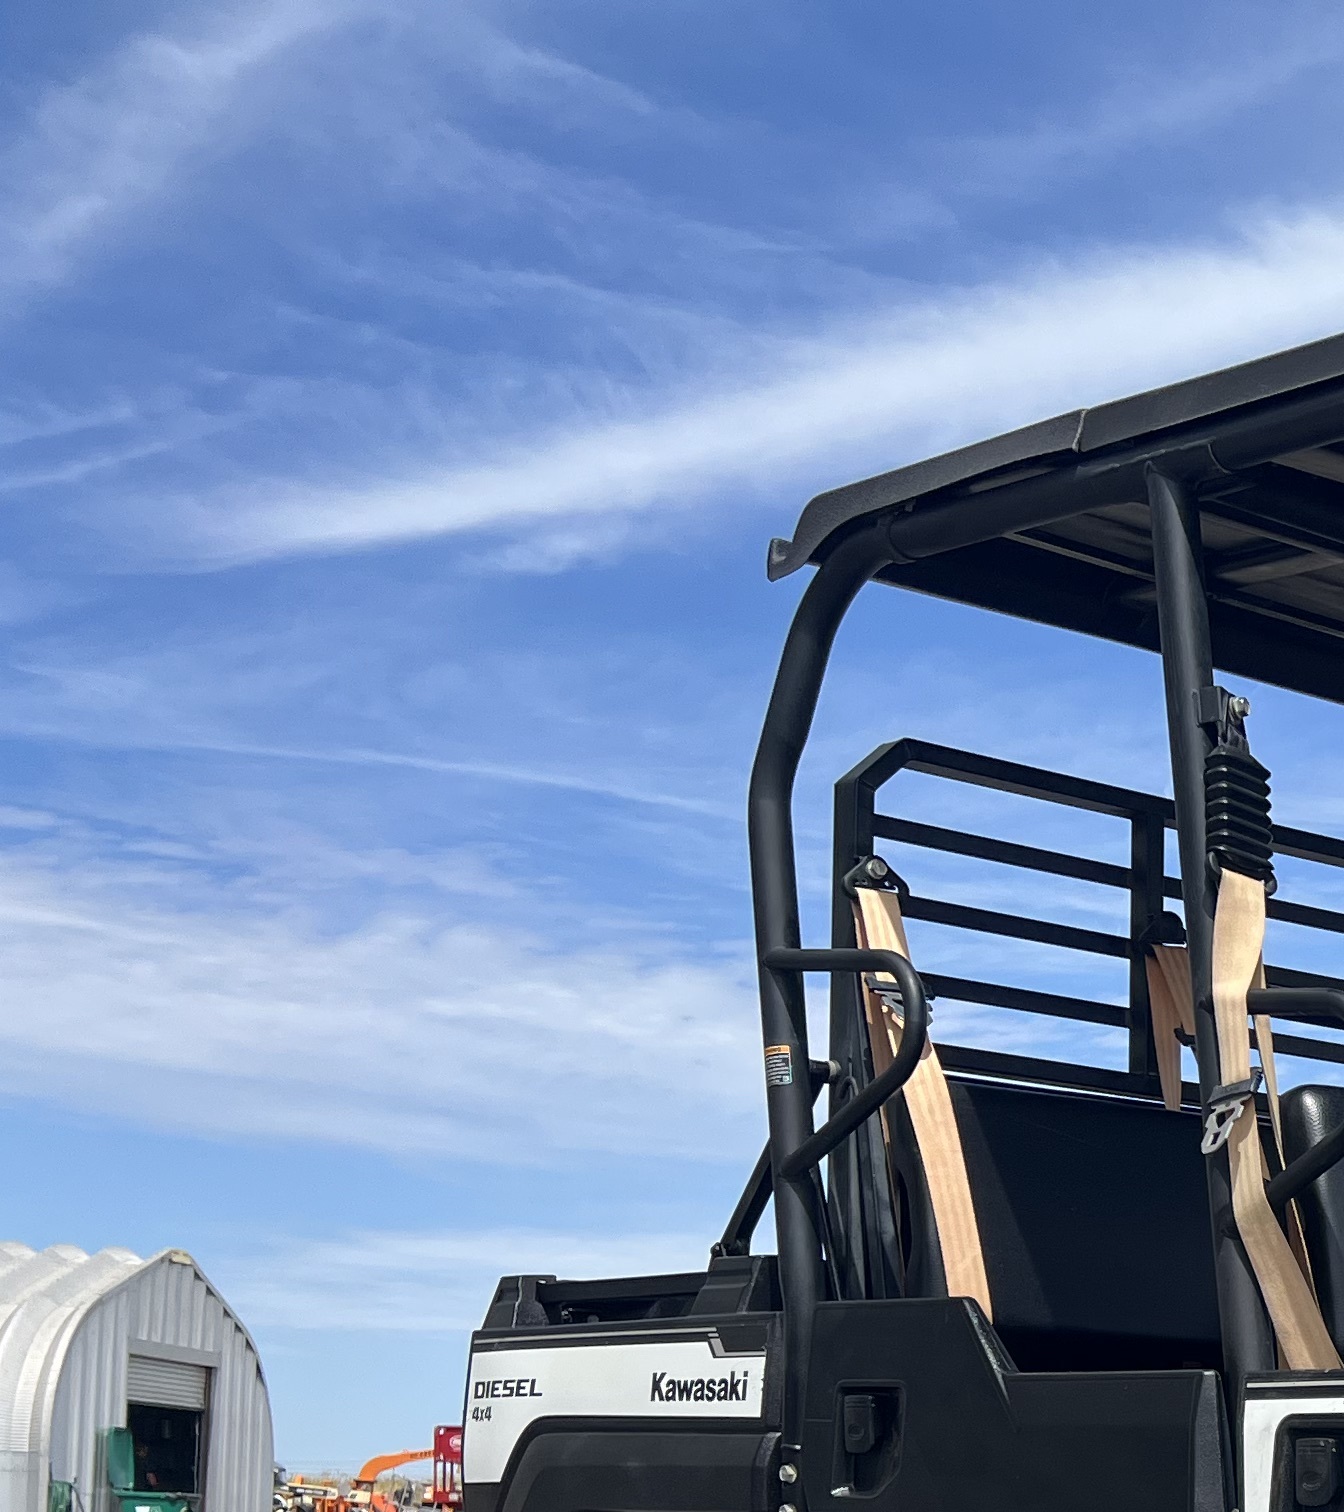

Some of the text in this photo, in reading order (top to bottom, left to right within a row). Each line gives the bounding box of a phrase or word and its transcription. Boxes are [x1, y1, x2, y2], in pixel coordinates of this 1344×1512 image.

[473, 1378, 543, 1399] DIESEL
[650, 1370, 749, 1402] Kawasaki
[472, 1405, 492, 1422] 4x4
